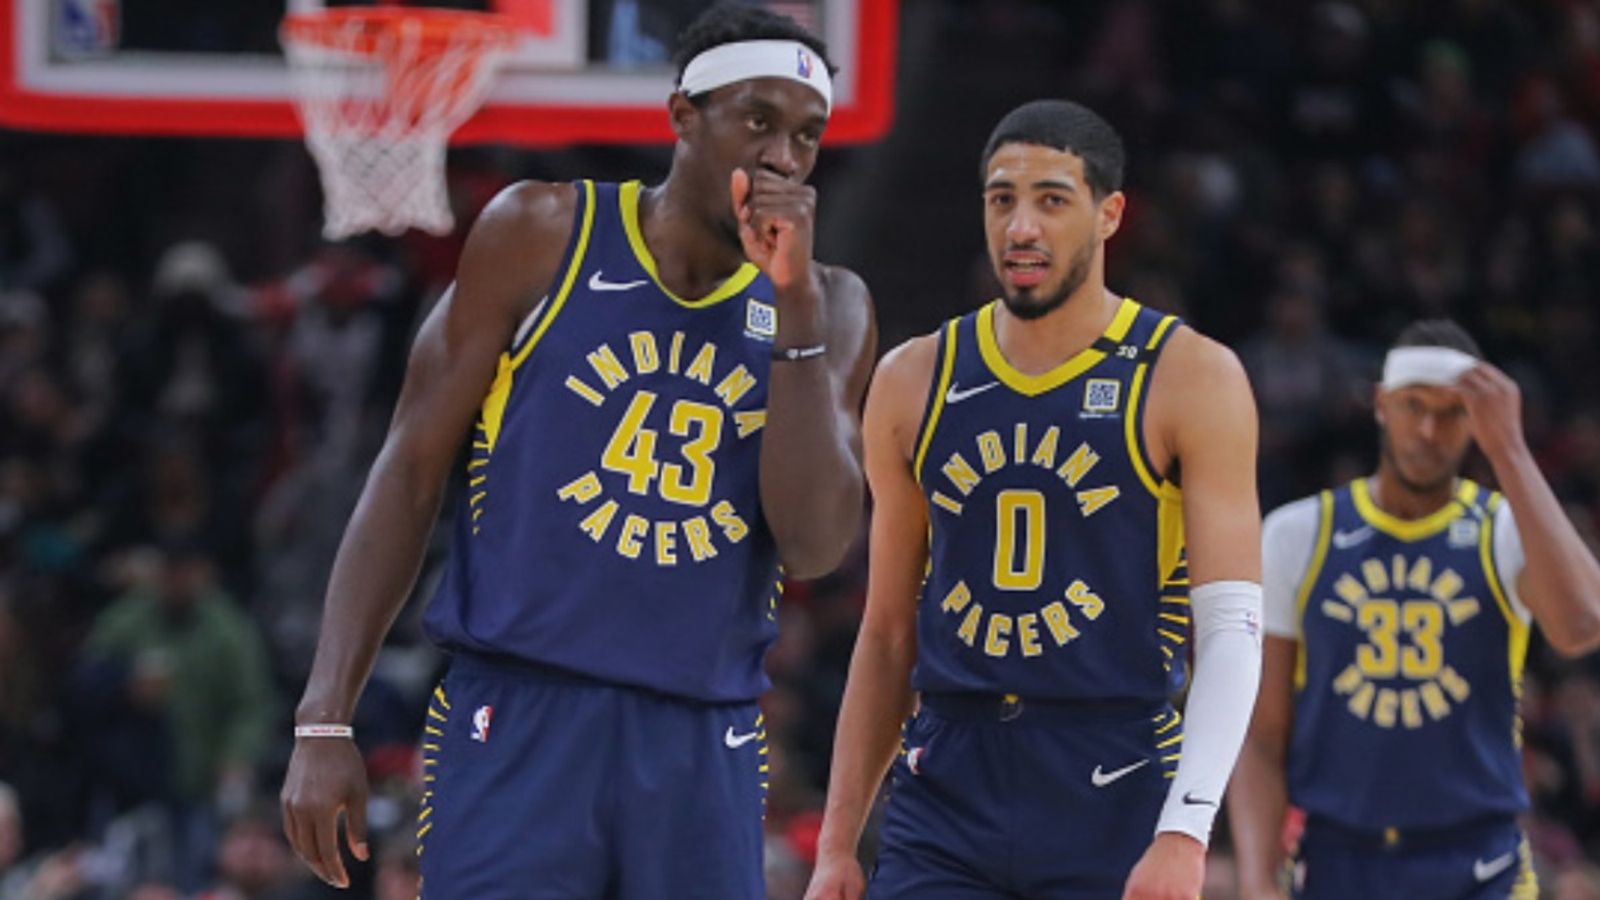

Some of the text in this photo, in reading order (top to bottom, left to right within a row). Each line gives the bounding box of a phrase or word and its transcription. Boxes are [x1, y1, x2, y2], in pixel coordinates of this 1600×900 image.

[565, 331, 767, 438] INDIANA
[601, 390, 723, 507] 43
[931, 423, 1121, 517] INDIANA
[557, 471, 748, 566] PACERS
[993, 489, 1045, 591] 0
[941, 580, 1105, 657] PACERS
[1321, 553, 1480, 626] INDIANA
[1356, 598, 1443, 678] 33
[1333, 665, 1470, 728] PACERS
